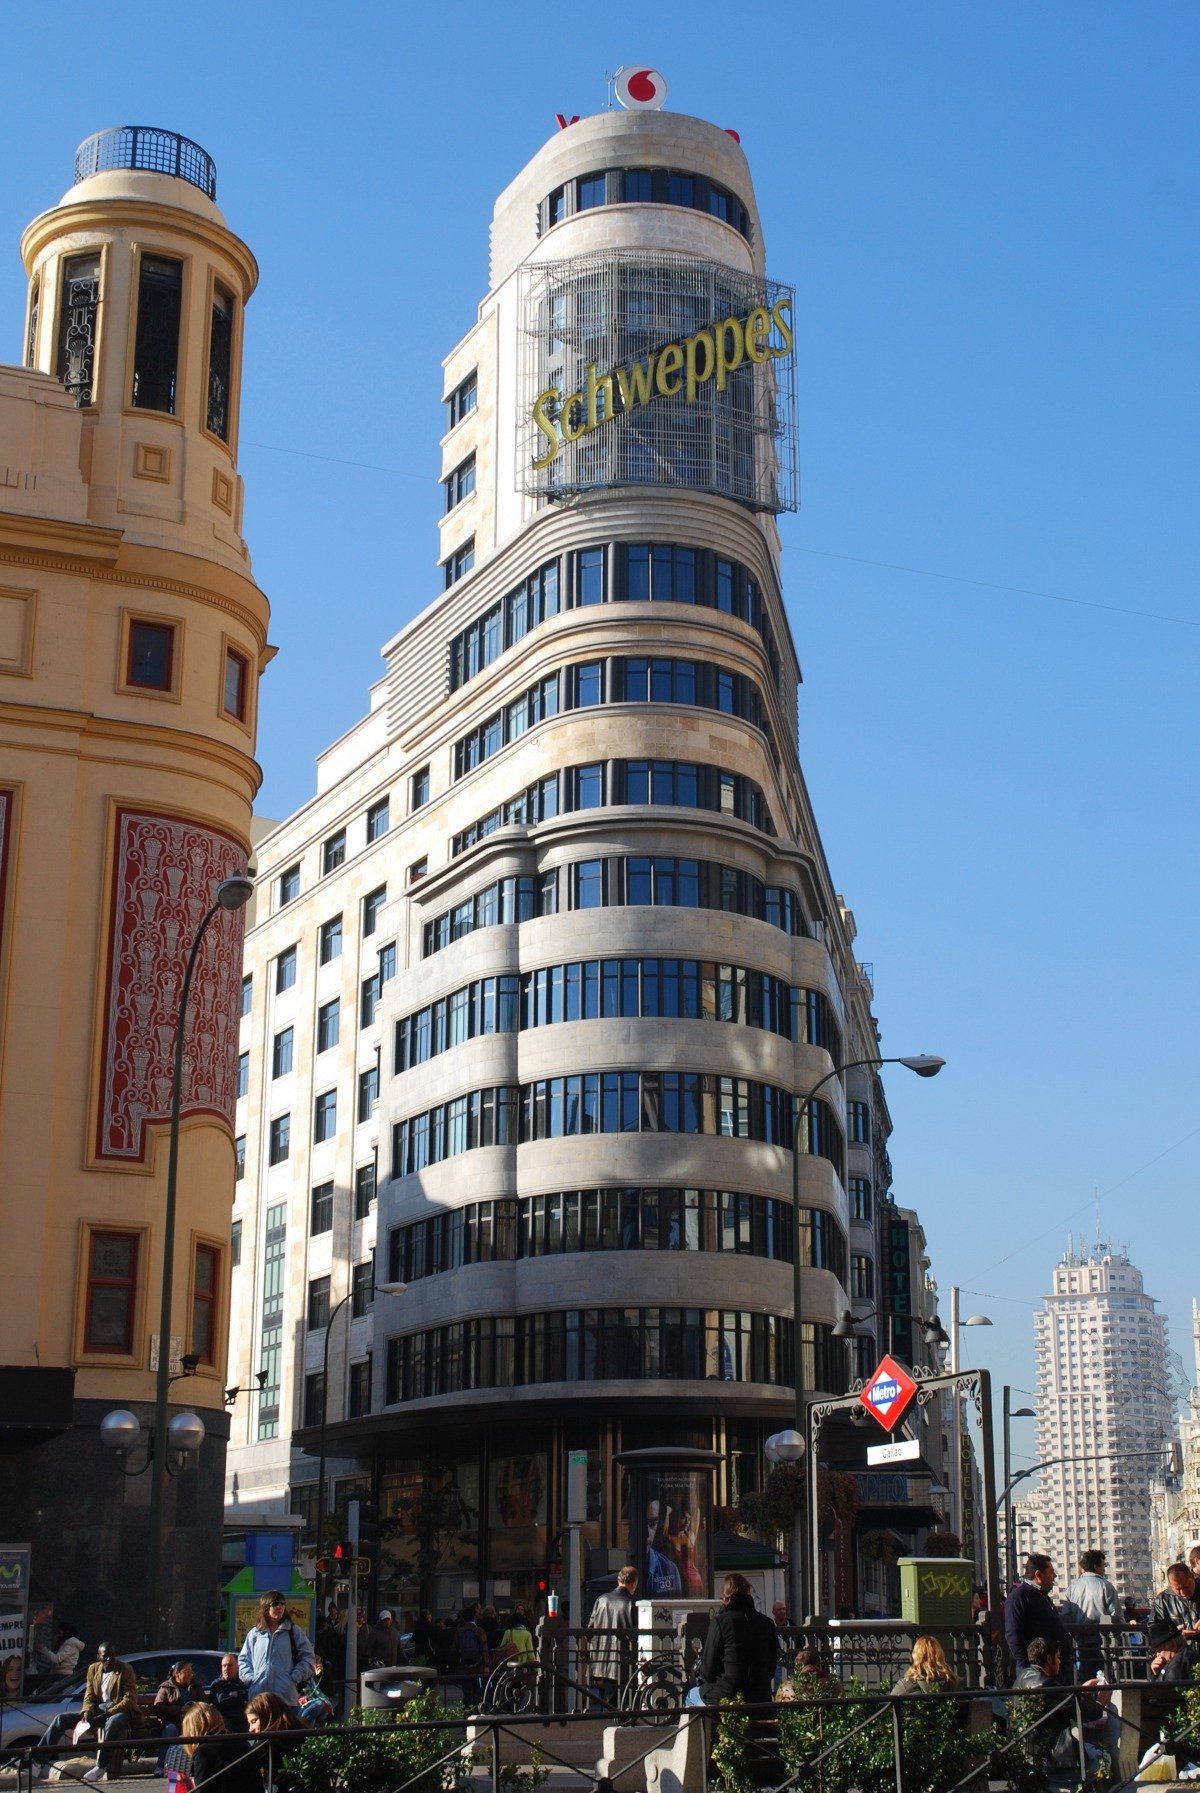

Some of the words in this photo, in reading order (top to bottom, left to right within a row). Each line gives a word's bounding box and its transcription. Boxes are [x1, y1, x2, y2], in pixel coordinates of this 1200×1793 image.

[532, 298, 793, 470] Schweppes
[891, 1226, 908, 1336] HOTEL
[872, 1385, 896, 1403] Metro
[856, 1475, 913, 1502] APITOL
[961, 1435, 973, 1500] HOTEL
[659, 1579, 672, 1589] 30
